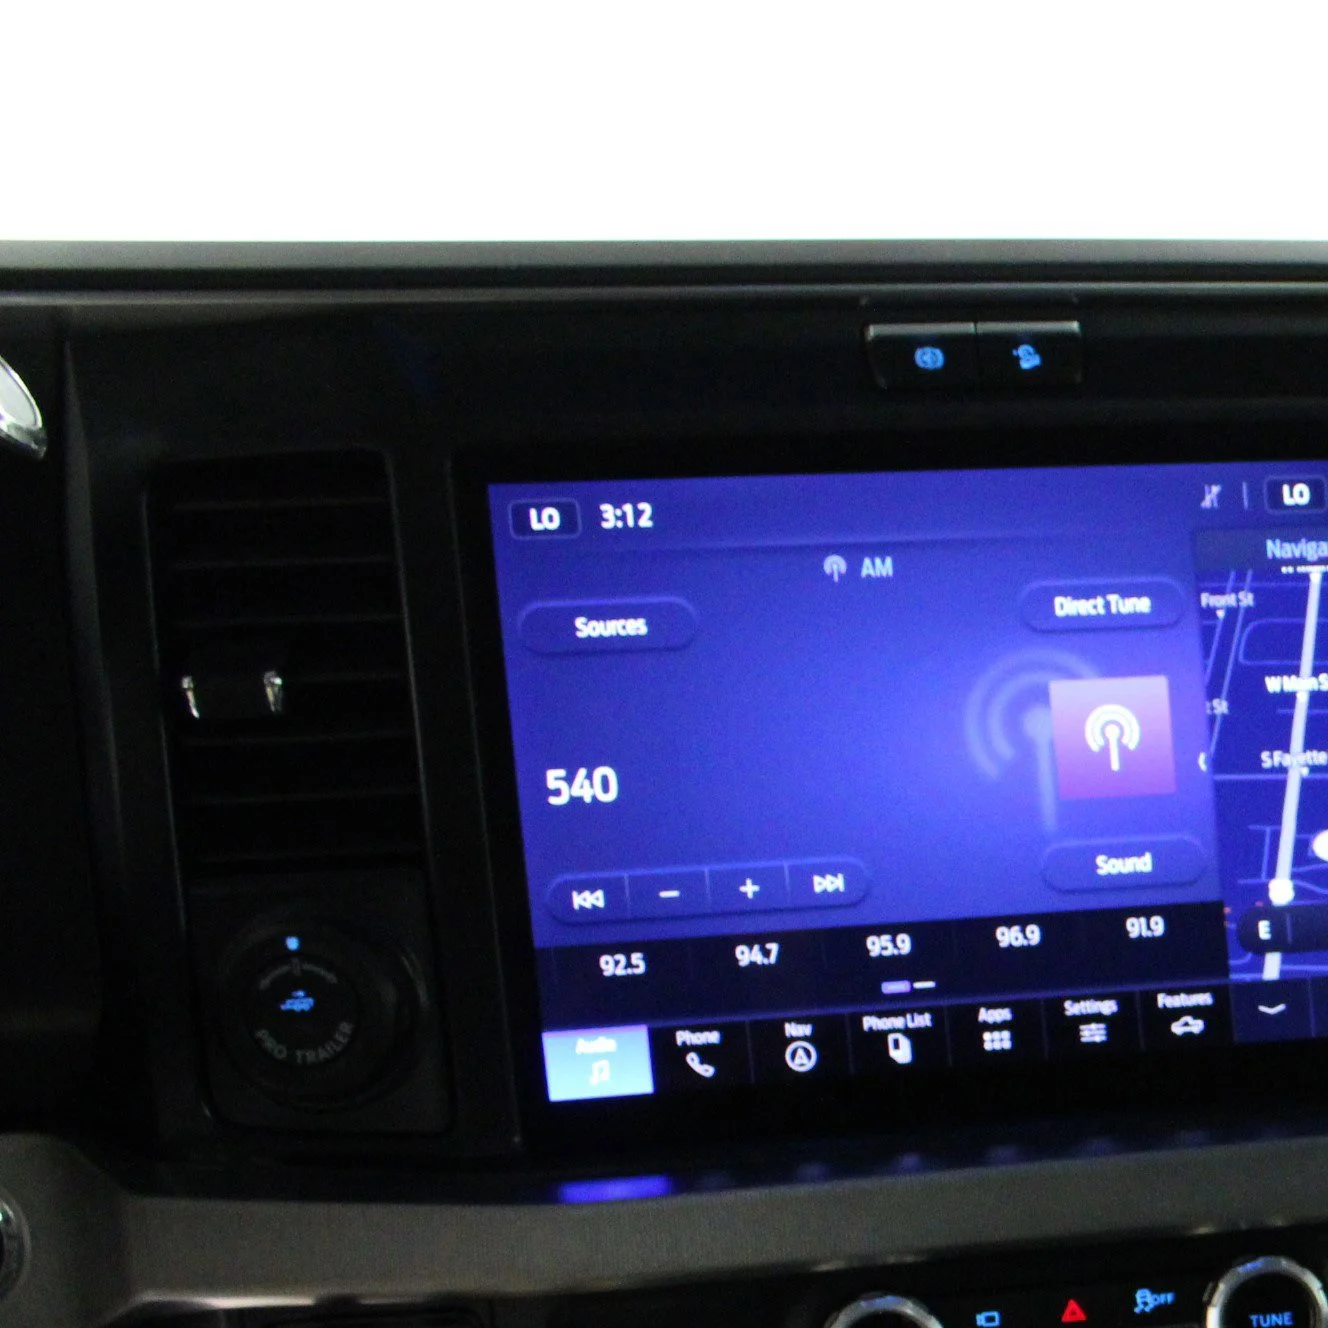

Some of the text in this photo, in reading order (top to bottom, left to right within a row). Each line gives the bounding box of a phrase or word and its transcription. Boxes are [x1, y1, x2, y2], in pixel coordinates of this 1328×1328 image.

[1281, 482, 1311, 506] LO
[527, 506, 561, 531] LO
[599, 502, 654, 529] 3:12
[860, 556, 894, 578] AM
[1054, 593, 1152, 617] Direct Tune
[574, 614, 649, 639] Sources
[1264, 675, 1282, 693] W
[545, 765, 619, 806] 540
[1095, 852, 1153, 876] Sound
[995, 923, 1041, 949] 96.9
[1125, 915, 1166, 939] 91.9
[1257, 919, 1272, 940] E
[734, 942, 780, 967] 94.7
[865, 932, 912, 958] 95.9
[599, 952, 646, 977] 92.5
[1063, 997, 1119, 1018] Settings
[1156, 991, 1214, 1010] Features
[862, 1011, 933, 1032] Phone List
[977, 1005, 1012, 1025] Apps
[675, 1029, 721, 1047] Phone
[783, 1021, 813, 1038] Nav
[1248, 1312, 1294, 1328] TUNE
